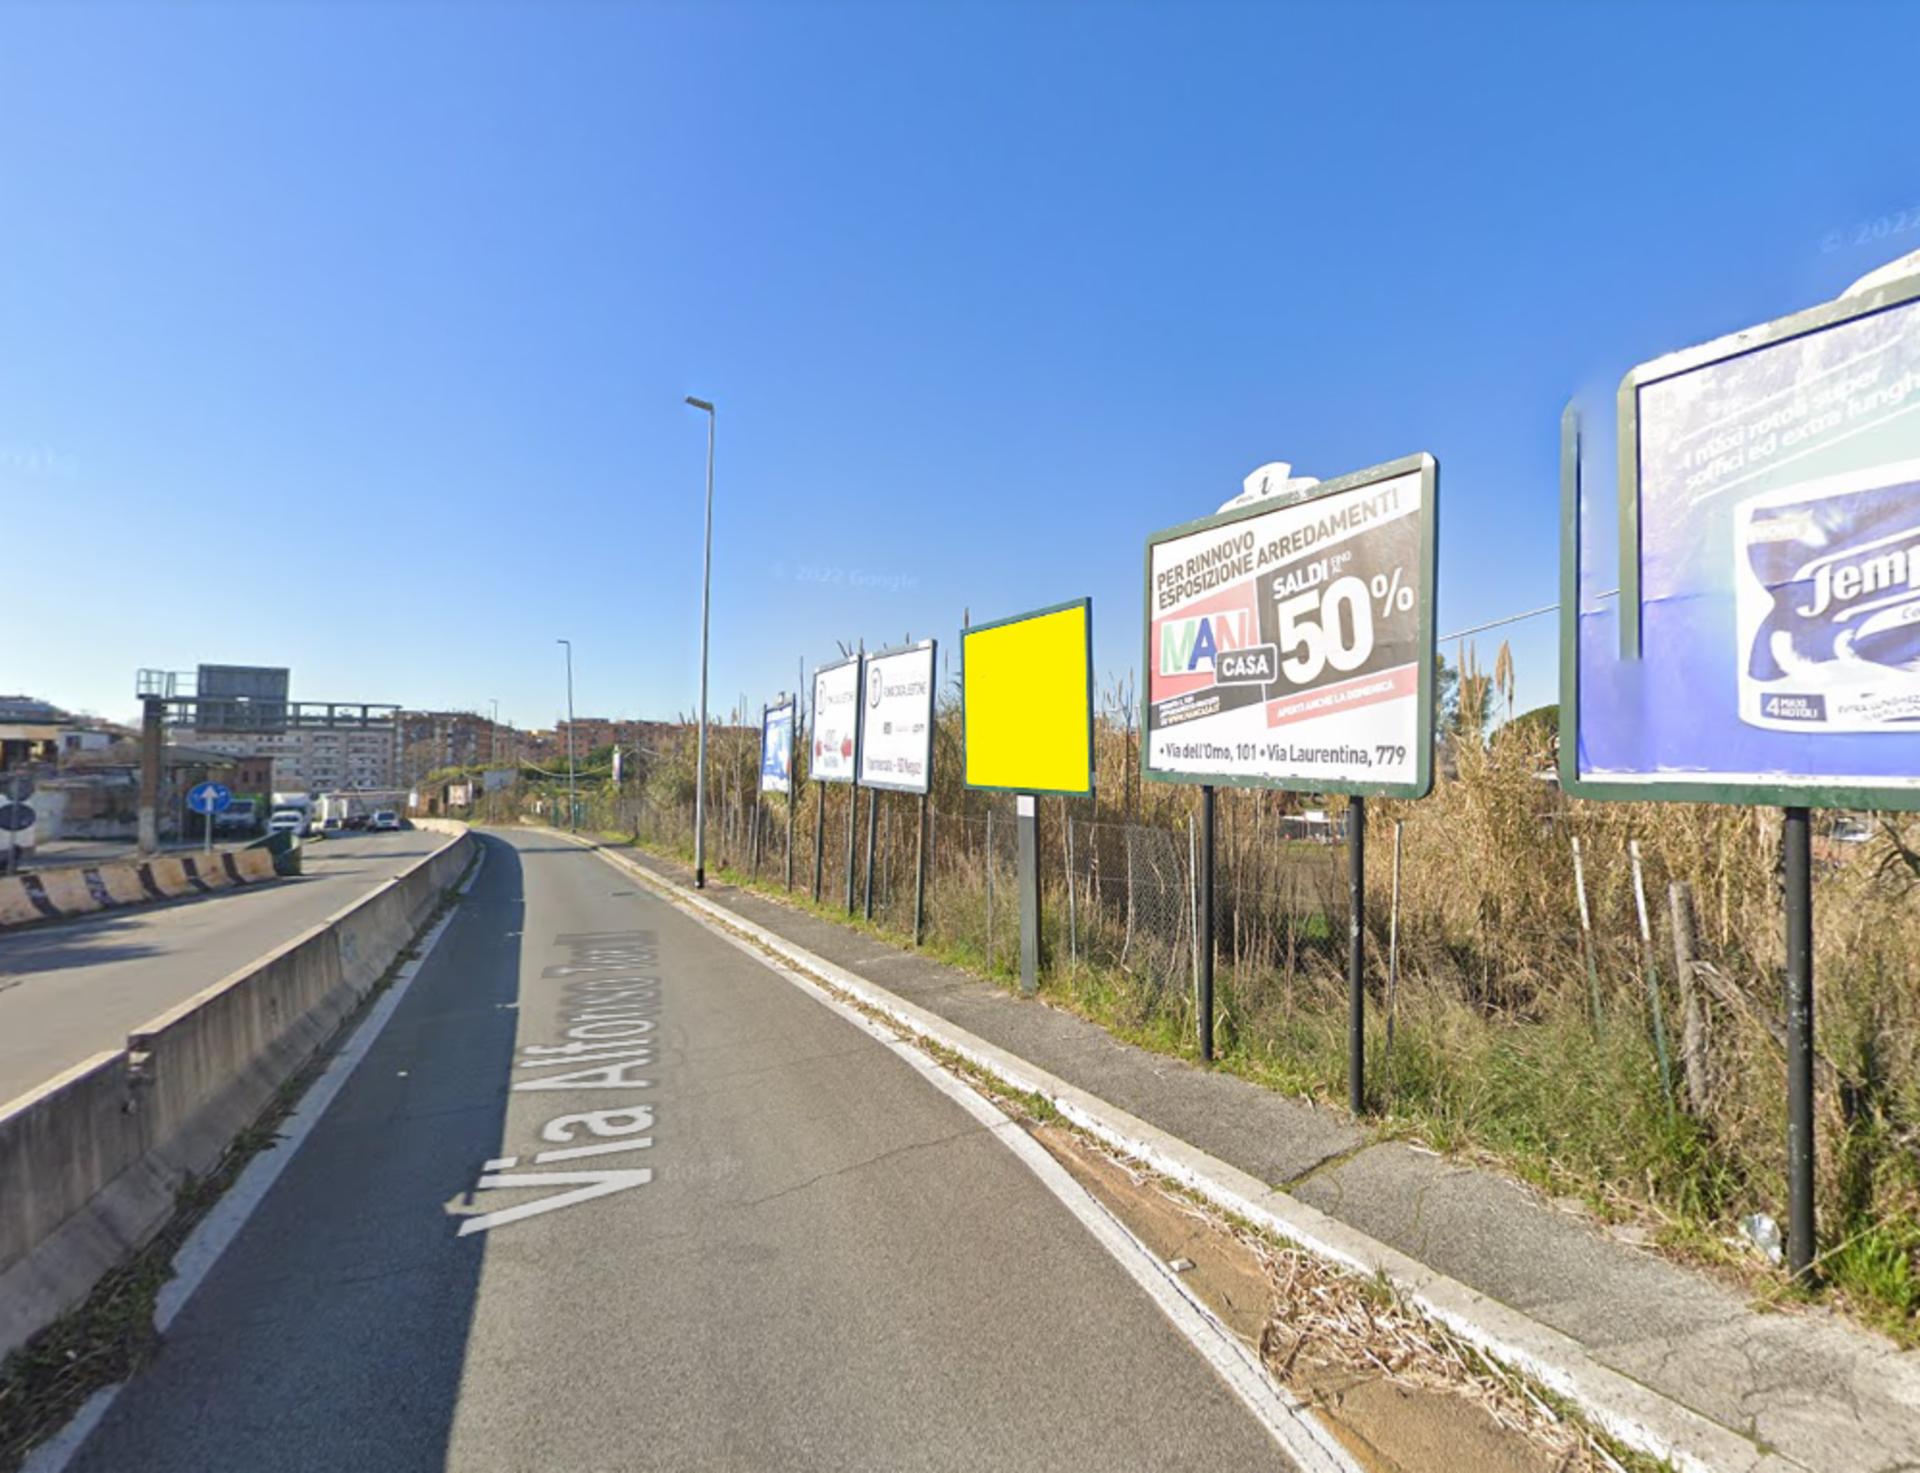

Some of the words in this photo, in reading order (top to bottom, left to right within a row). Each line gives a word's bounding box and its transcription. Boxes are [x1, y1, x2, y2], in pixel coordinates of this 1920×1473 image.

[1159, 551, 1254, 610] ESPOSIZIONE
[1256, 486, 1400, 568] ARREDAMENTI
[1157, 564, 1184, 591] PER
[1186, 530, 1255, 578] RINNOVO
[1272, 559, 1329, 599] SALDI
[1222, 654, 1269, 677] CASA
[1766, 697, 1779, 716] 4
[1165, 743, 1181, 758] Via
[1236, 743, 1257, 760] 101
[1266, 744, 1287, 761] Via
[1290, 745, 1372, 767] Laurentina,
[1375, 745, 1406, 765] 779
